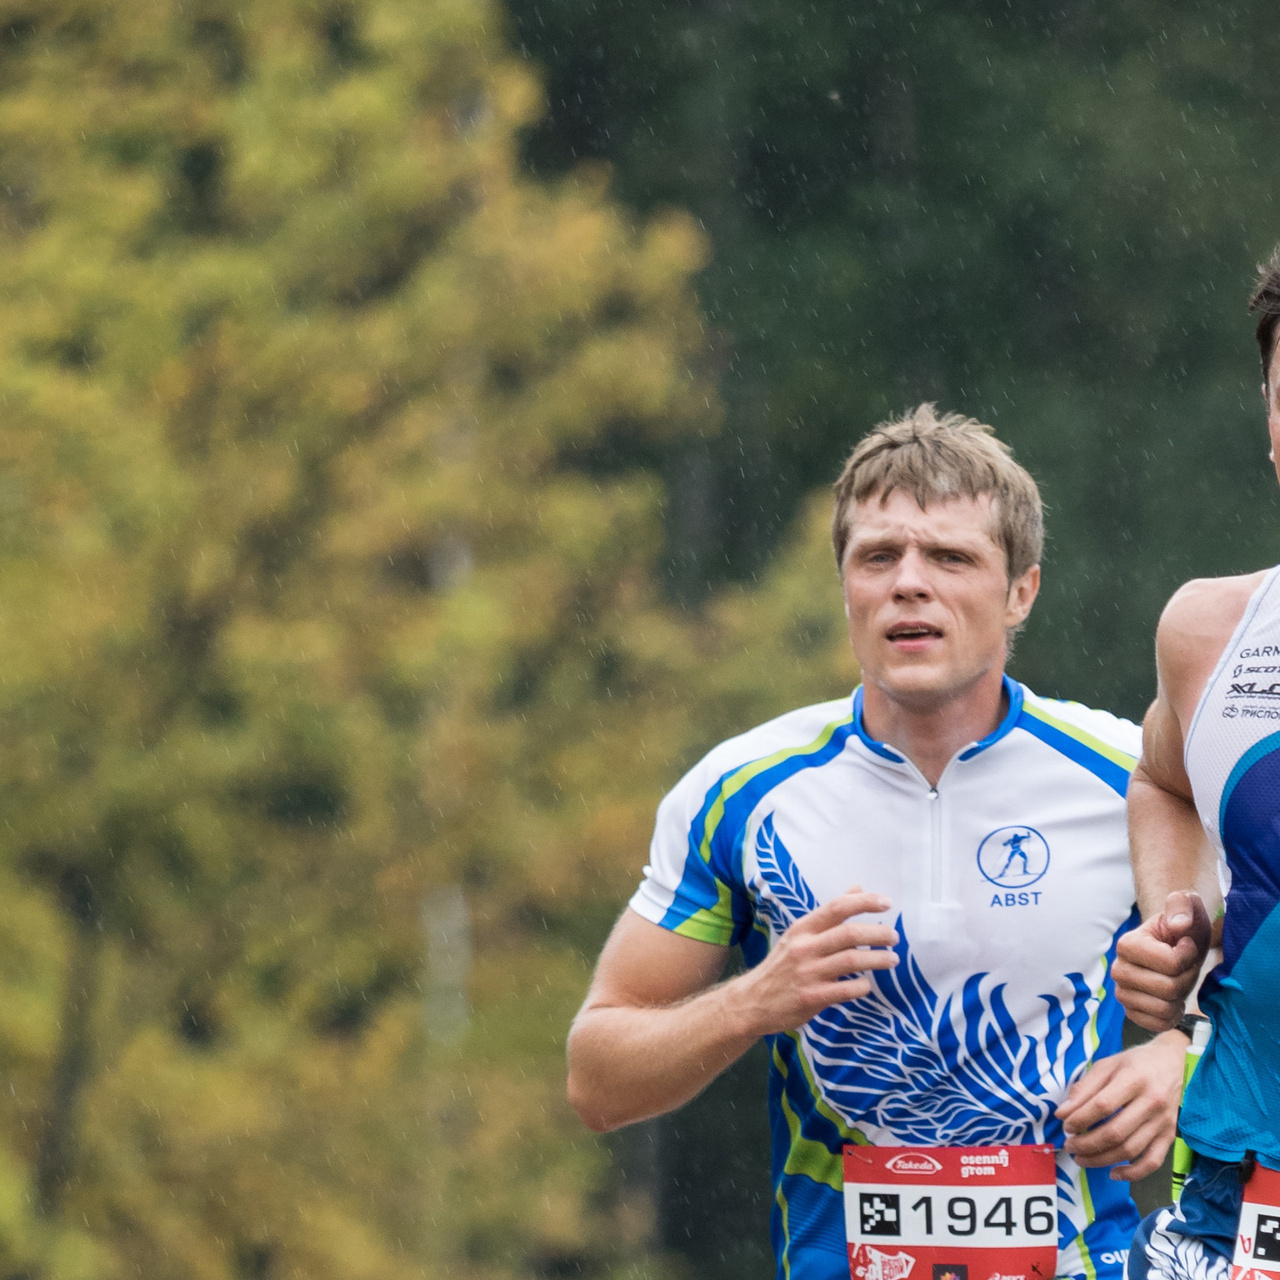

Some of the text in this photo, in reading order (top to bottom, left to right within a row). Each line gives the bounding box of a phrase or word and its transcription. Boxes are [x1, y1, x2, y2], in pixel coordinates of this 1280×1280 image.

[990, 891, 1043, 908] ABST
[896, 1160, 934, 1171] Takeda
[960, 1165, 996, 1179] grom
[911, 1195, 1055, 1237] 1946
